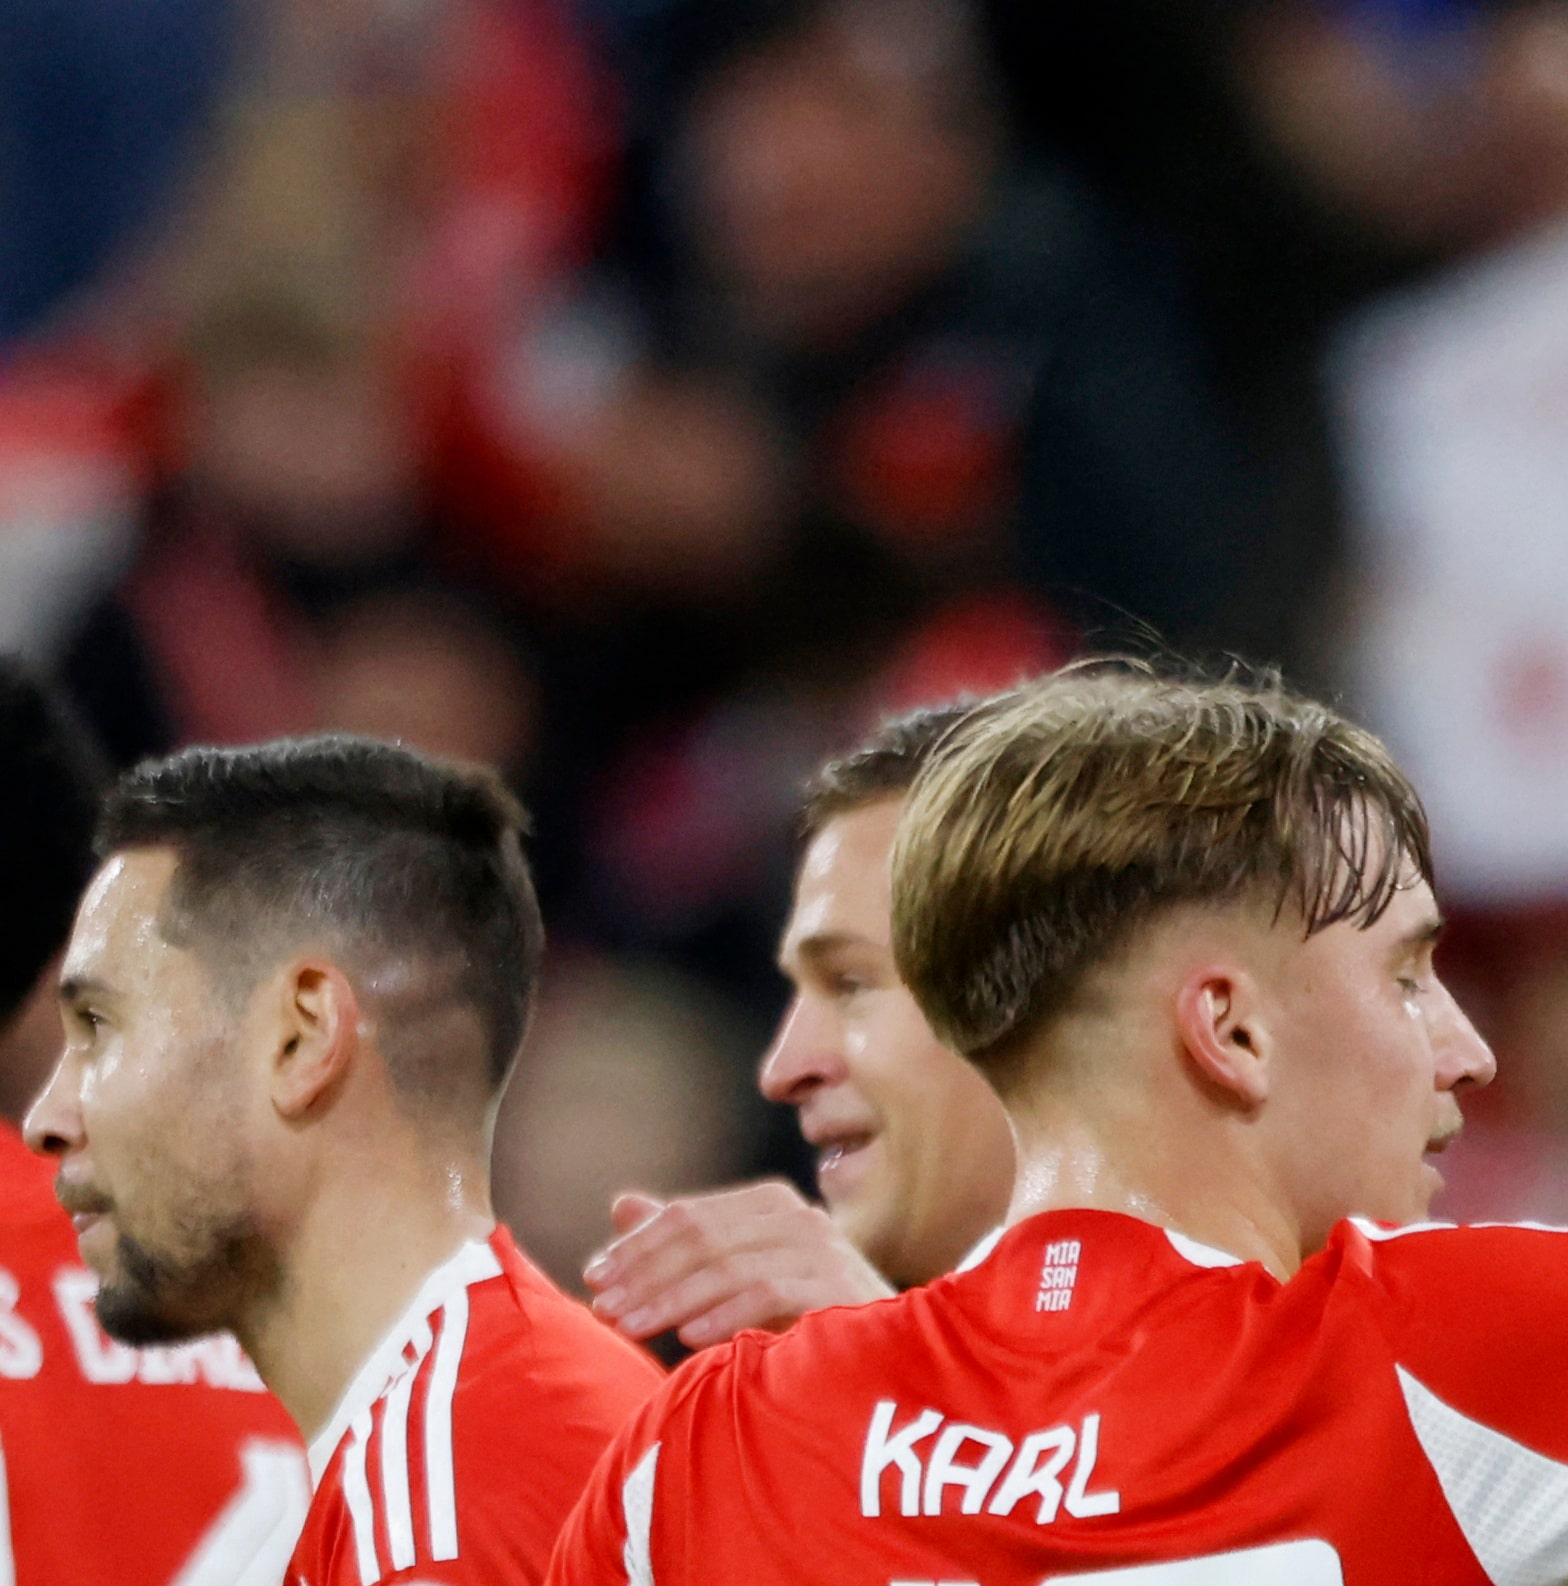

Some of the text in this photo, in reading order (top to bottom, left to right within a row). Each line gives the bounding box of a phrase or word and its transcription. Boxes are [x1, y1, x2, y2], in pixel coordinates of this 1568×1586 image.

[1044, 1240, 1082, 1267] MIA
[1040, 1265, 1078, 1289] SAN
[1035, 1288, 1073, 1313] MIA
[860, 1400, 1121, 1526] KARL
